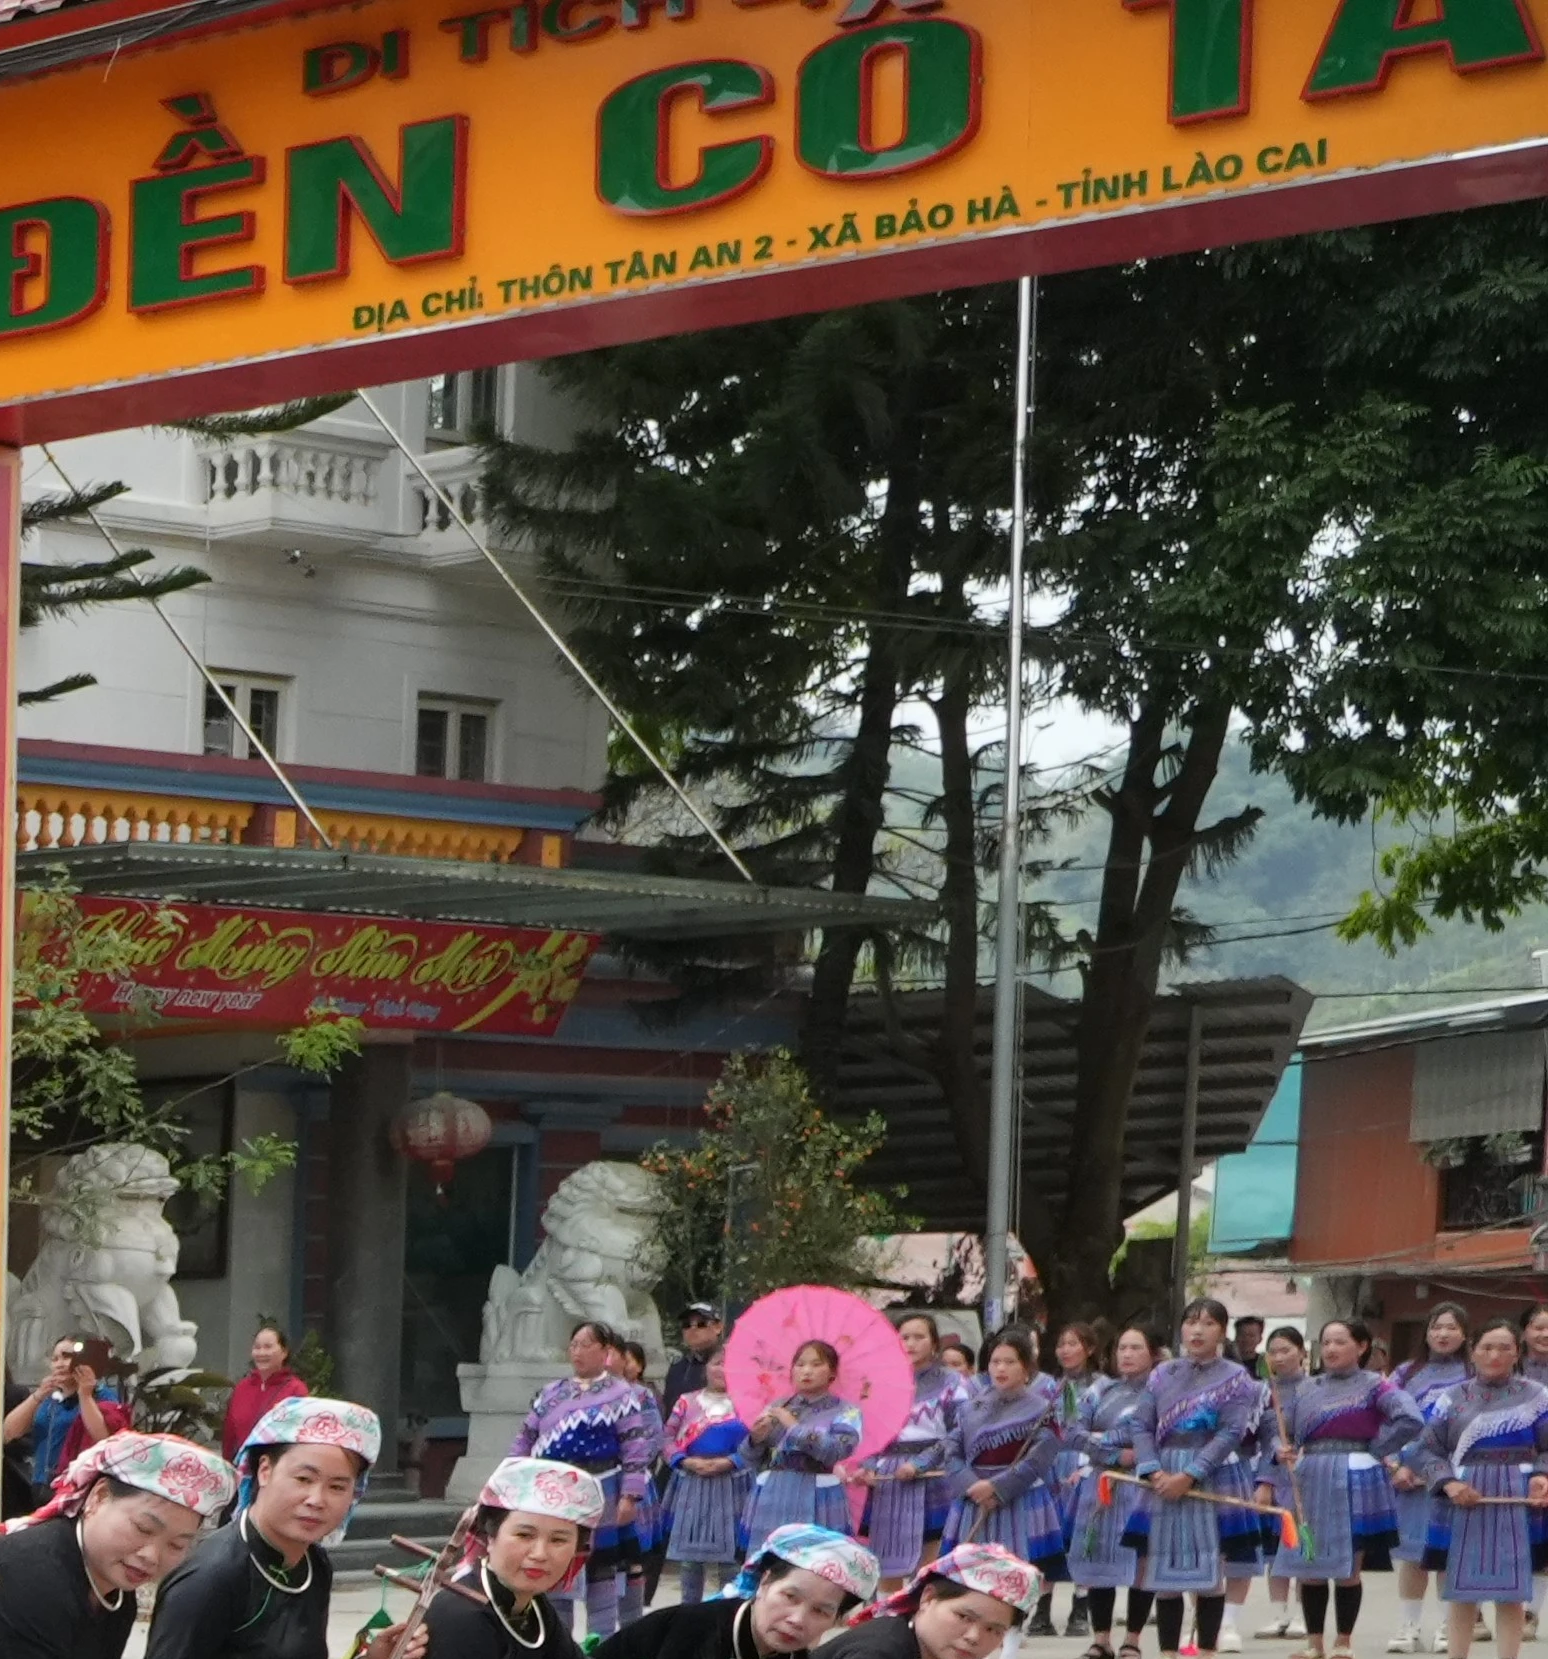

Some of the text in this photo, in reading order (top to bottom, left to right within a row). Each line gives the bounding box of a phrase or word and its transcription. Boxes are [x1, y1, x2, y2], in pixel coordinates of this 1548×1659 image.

[303, 29, 410, 96] DI
[354, 300, 410, 332] ĐỊA
[498, 264, 594, 304] THÔN
[606, 250, 678, 287] TÂN
[689, 240, 741, 272] AN
[753, 235, 775, 260] 2
[807, 212, 859, 252] XÃ
[875, 200, 954, 240] BẢO
[967, 183, 1021, 224] HÀ
[1058, 168, 1148, 210] TỈNH
[1163, 150, 1244, 192] LÀO
[1256, 137, 1328, 174] CAI
[175, 990, 217, 1009] new
[212, 991, 264, 1013] year
